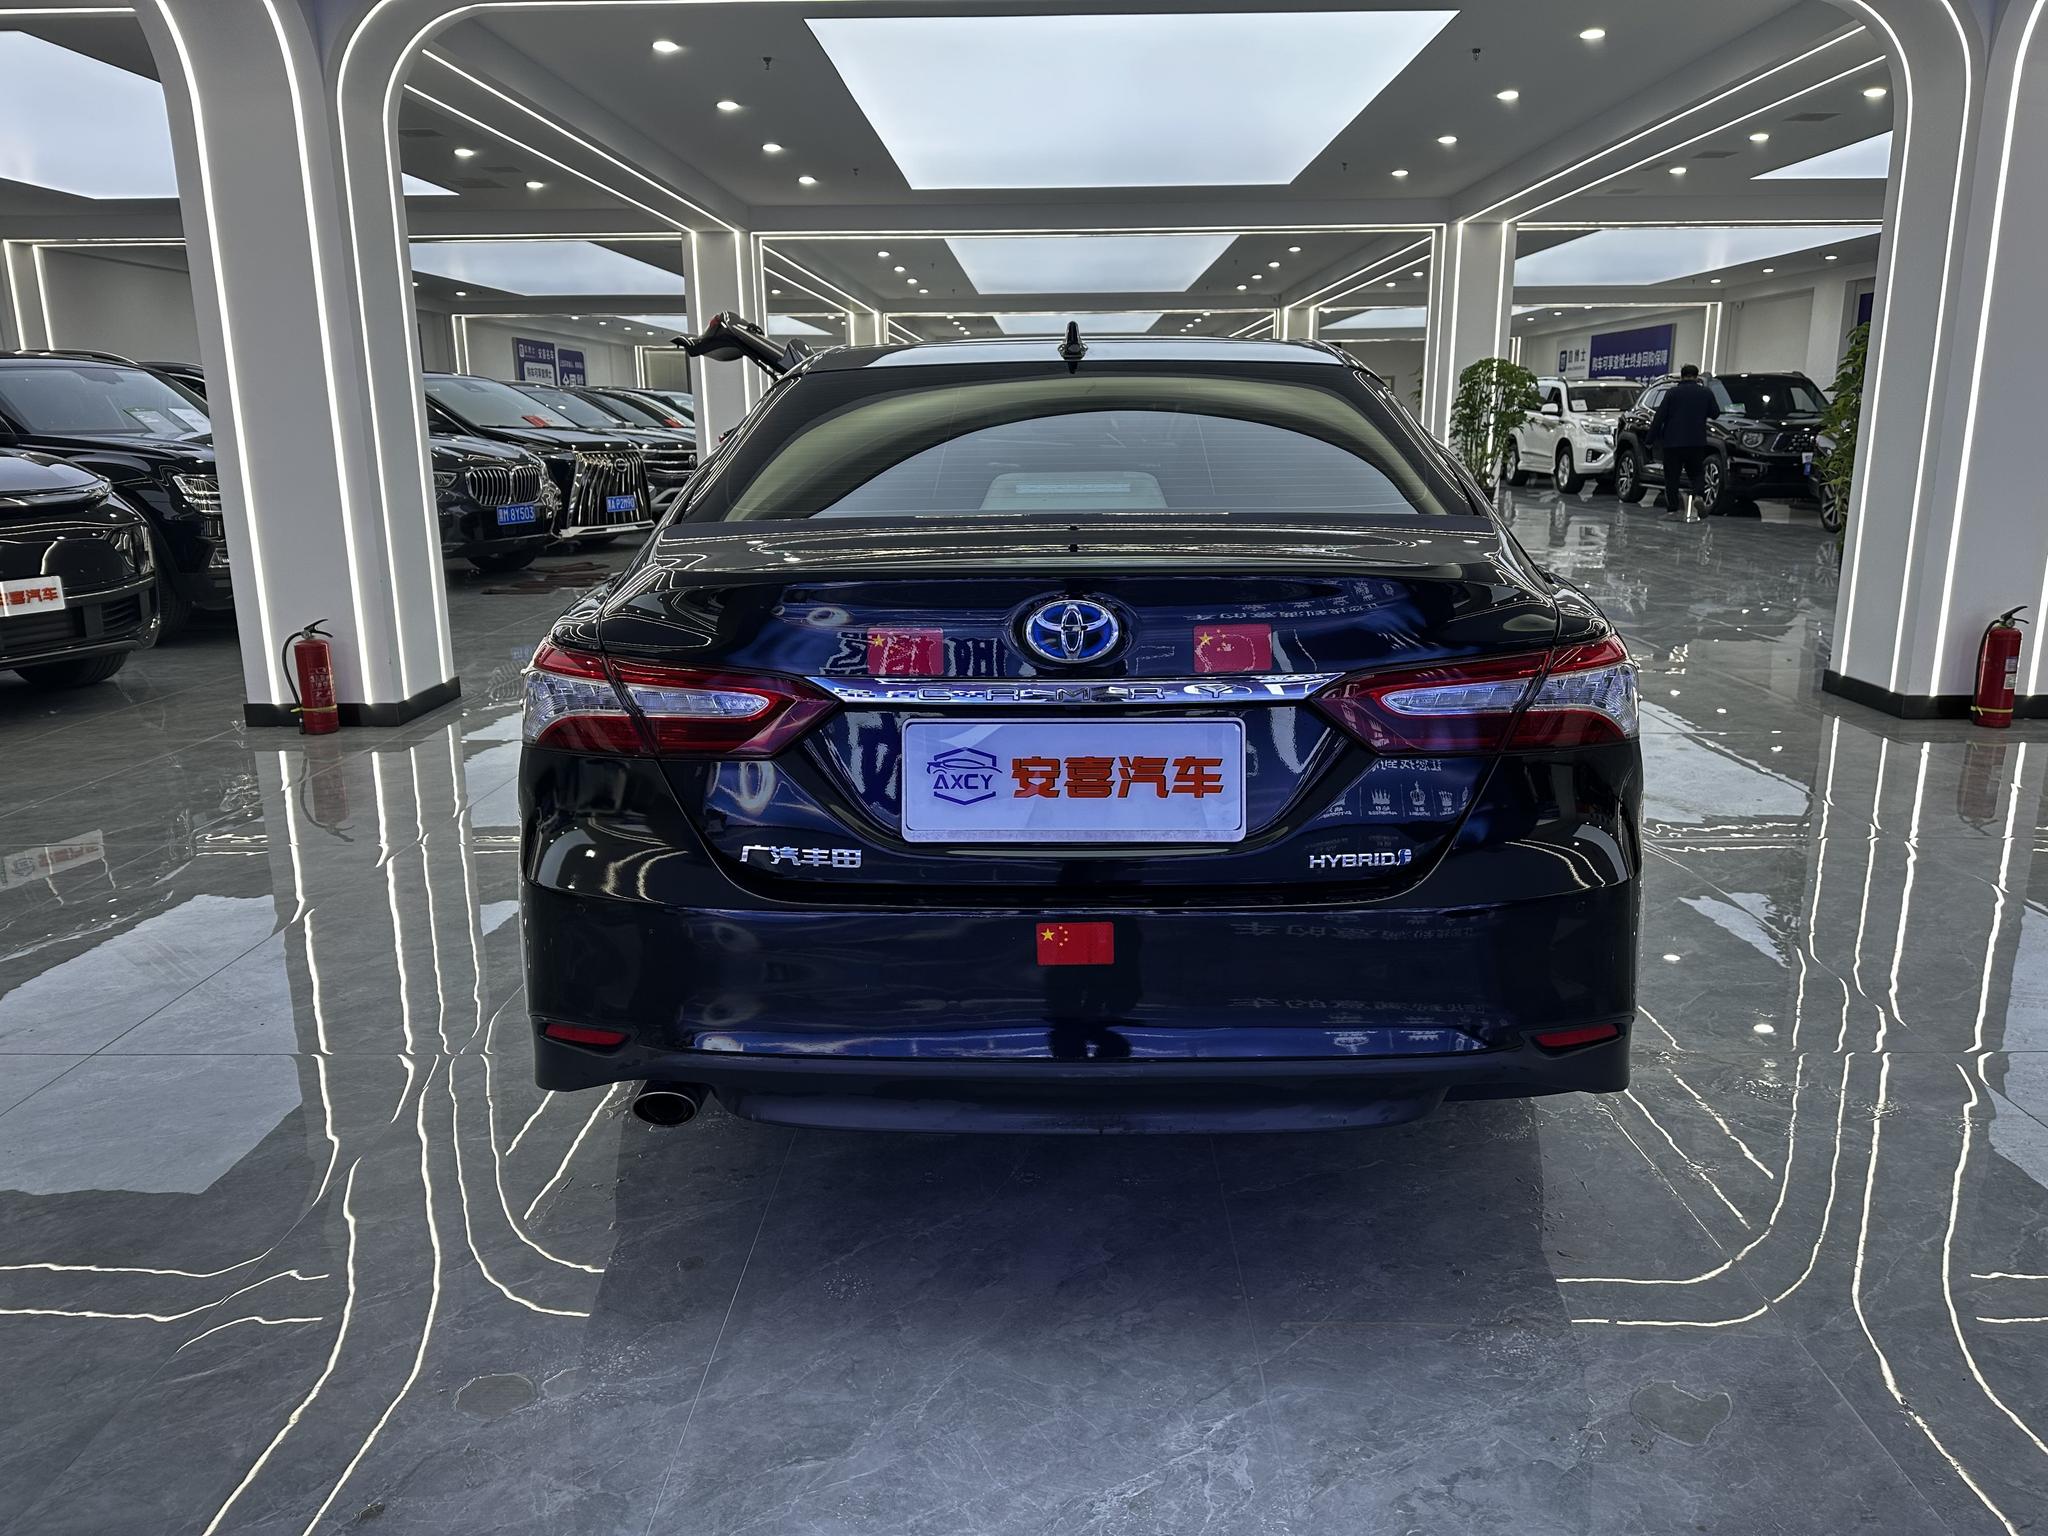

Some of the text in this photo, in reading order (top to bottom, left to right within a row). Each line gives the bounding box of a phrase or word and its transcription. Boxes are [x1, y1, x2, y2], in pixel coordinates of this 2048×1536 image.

[917, 685, 1236, 701] CAMRY
[933, 773, 993, 790] AXCY
[1012, 756, 1224, 798] 安喜汽车
[740, 845, 861, 868] 广汽丰田
[1309, 852, 1396, 869] HYBRID
